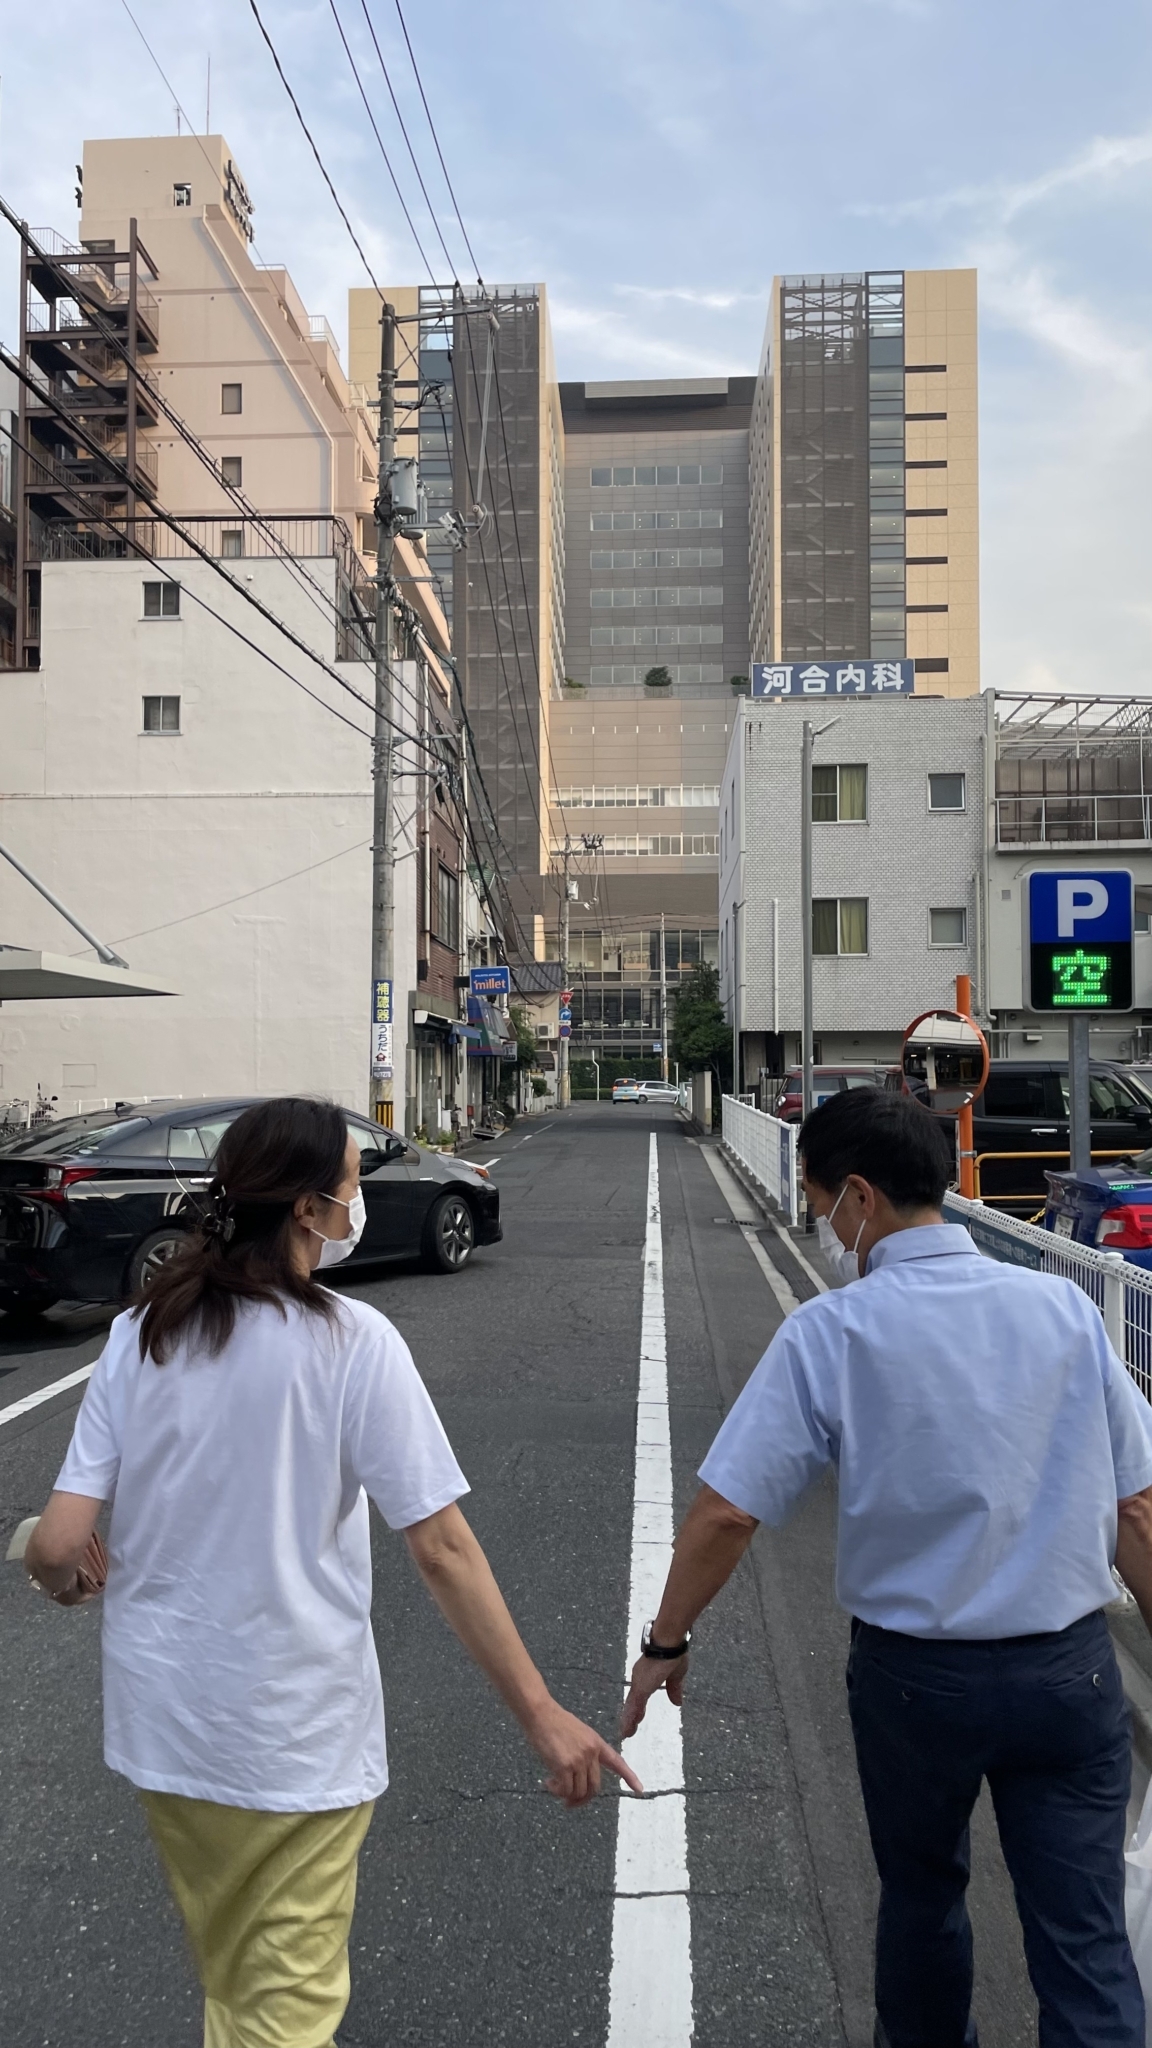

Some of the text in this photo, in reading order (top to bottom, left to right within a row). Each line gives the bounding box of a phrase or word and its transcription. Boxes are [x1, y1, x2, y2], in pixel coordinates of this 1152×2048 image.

[761, 662, 905, 694] 河合内科
[1057, 879, 1109, 937] P
[1052, 949, 1108, 1004] 空
[376, 982, 390, 1022] 補聴器
